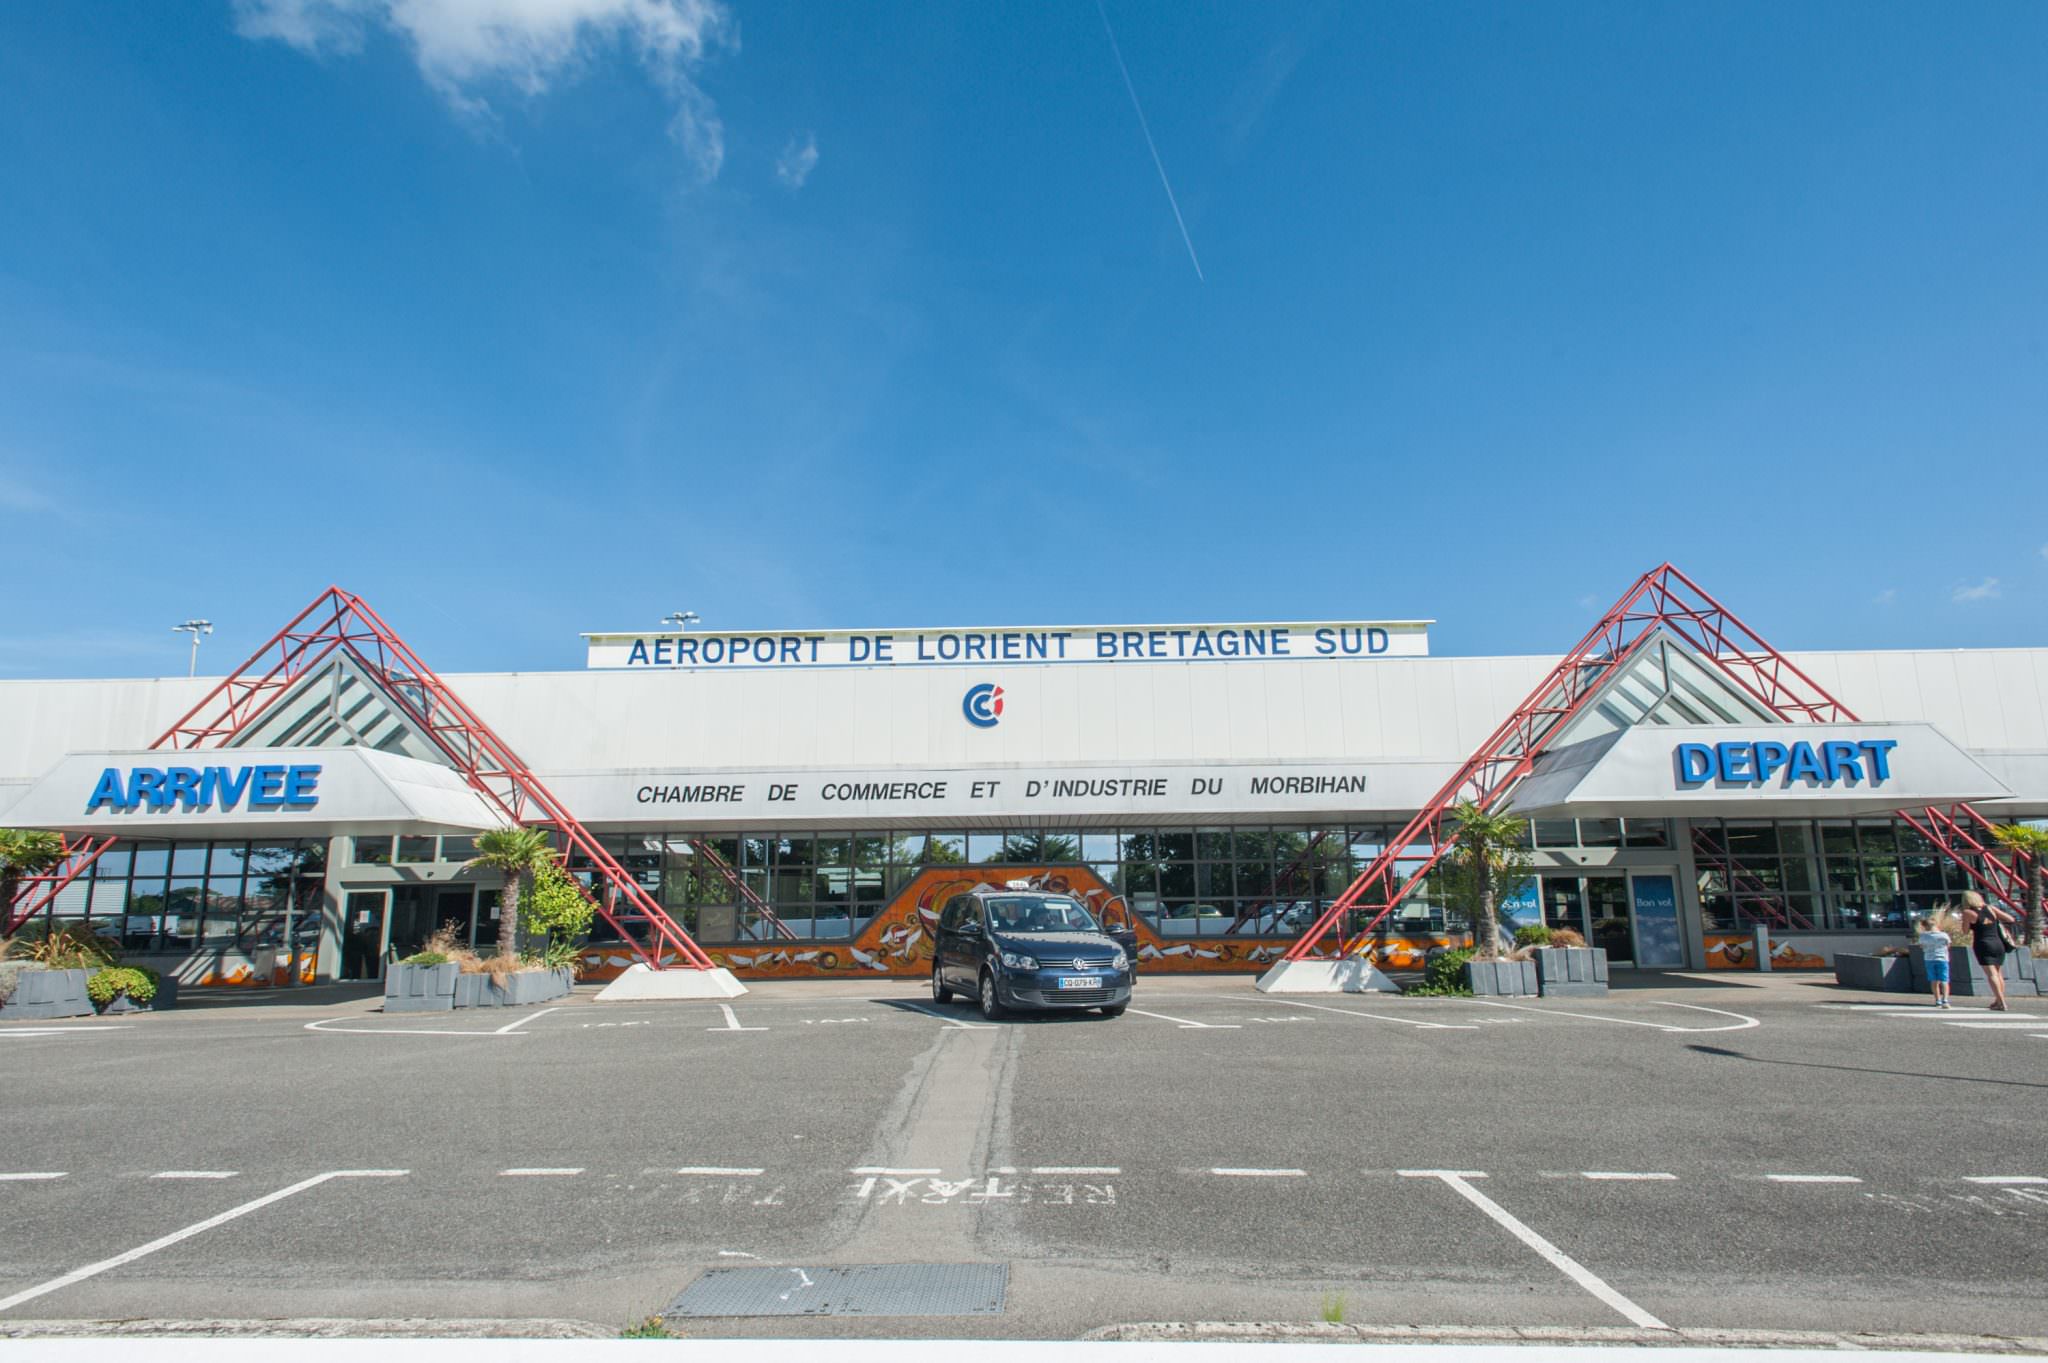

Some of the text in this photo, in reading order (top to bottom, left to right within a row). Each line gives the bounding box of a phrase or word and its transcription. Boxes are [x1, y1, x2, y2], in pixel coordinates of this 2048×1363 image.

[849, 636, 893, 661] DE
[917, 632, 1072, 660] LORIENT
[1096, 629, 1290, 657] BRETAGNE
[1314, 627, 1389, 654] SUD
[1676, 739, 1898, 783] DEPART
[87, 764, 322, 809] ARRIVEE
[636, 785, 745, 803] CHAMBRE
[767, 784, 799, 801] DE
[821, 782, 947, 801] COMMERCE
[970, 781, 1001, 798] ET
[1191, 778, 1223, 795] DU
[1250, 776, 1367, 794] MORBIHAN
[1636, 897, 1656, 907] Bon
[856, 1177, 1013, 1198] TAXI
